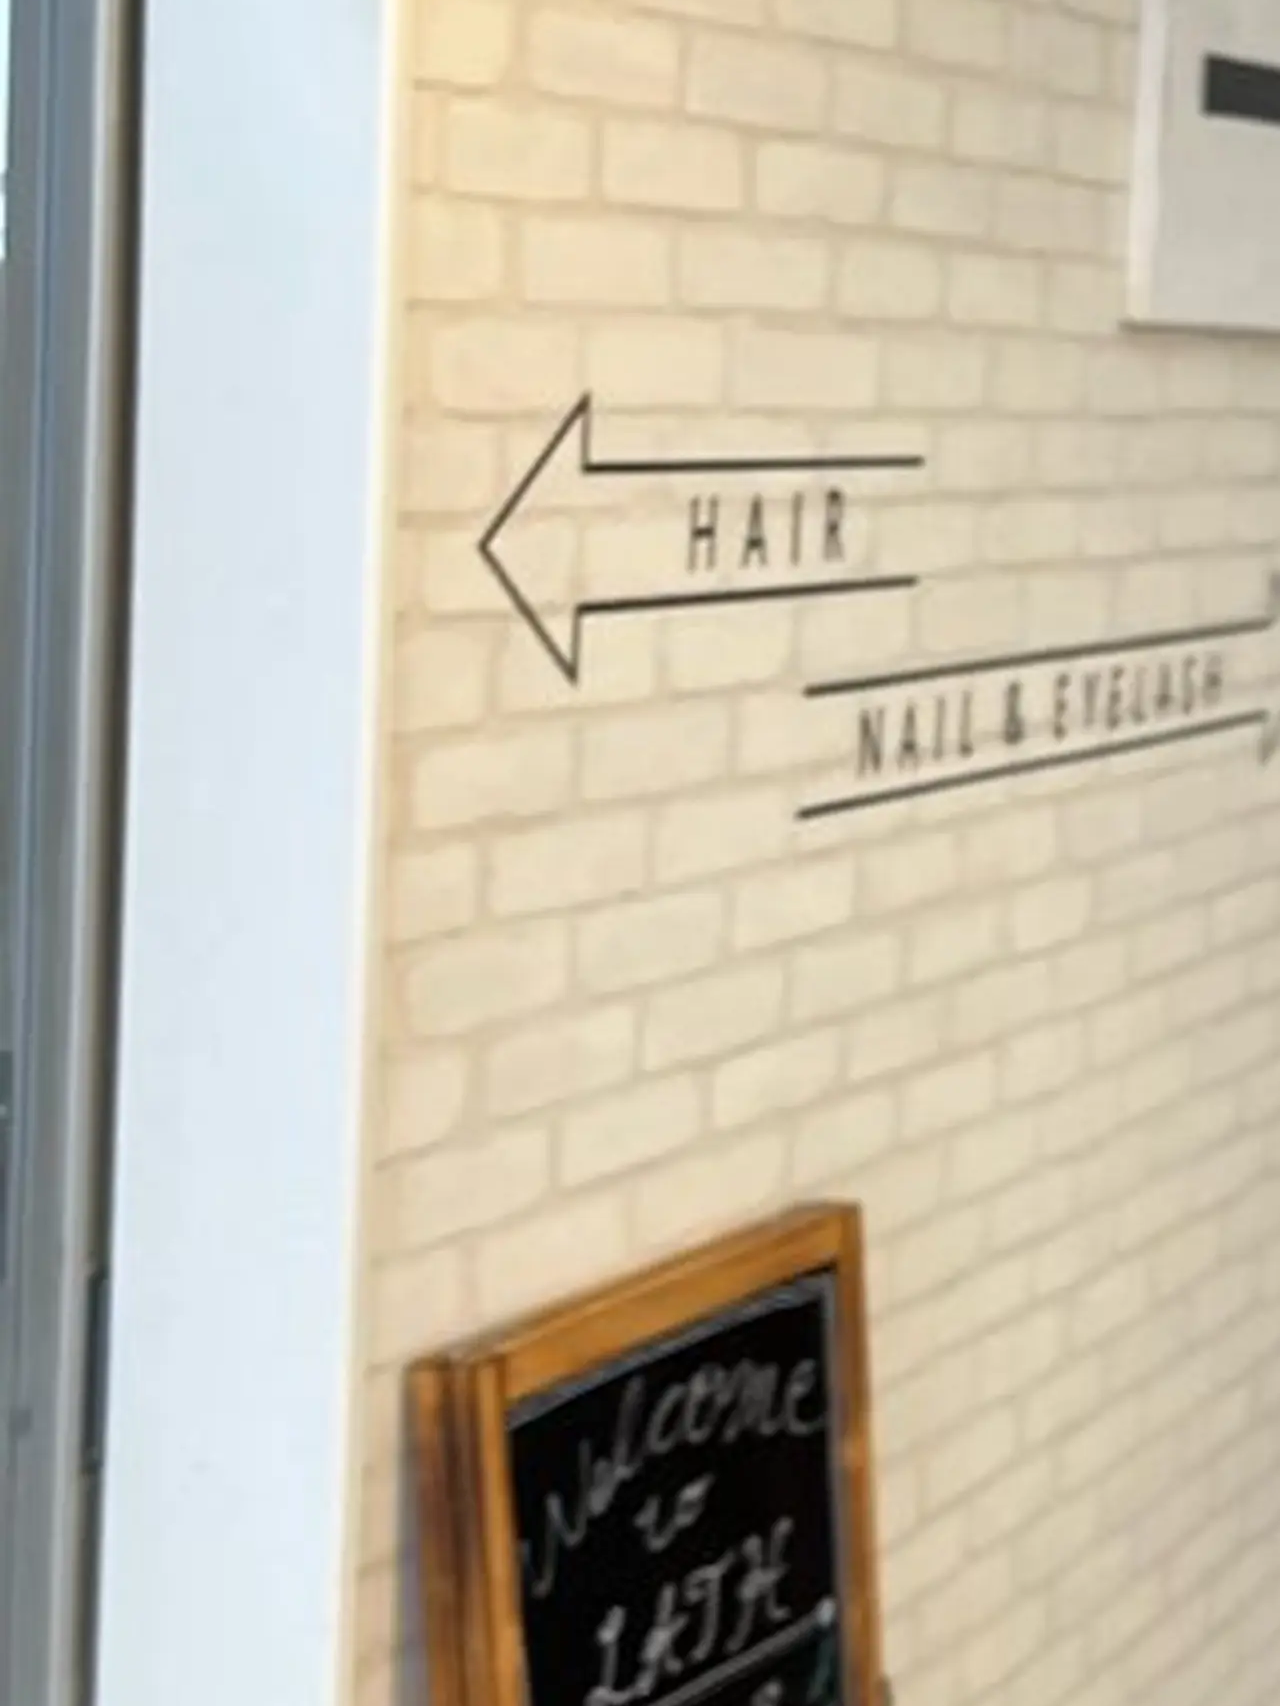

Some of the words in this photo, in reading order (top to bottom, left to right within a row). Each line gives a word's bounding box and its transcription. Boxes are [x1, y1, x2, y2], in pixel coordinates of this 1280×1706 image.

[686, 487, 844, 572] HAIR
[856, 706, 973, 777] NAIL
[1003, 681, 1025, 745] &
[1052, 654, 1222, 741] EYELASH
